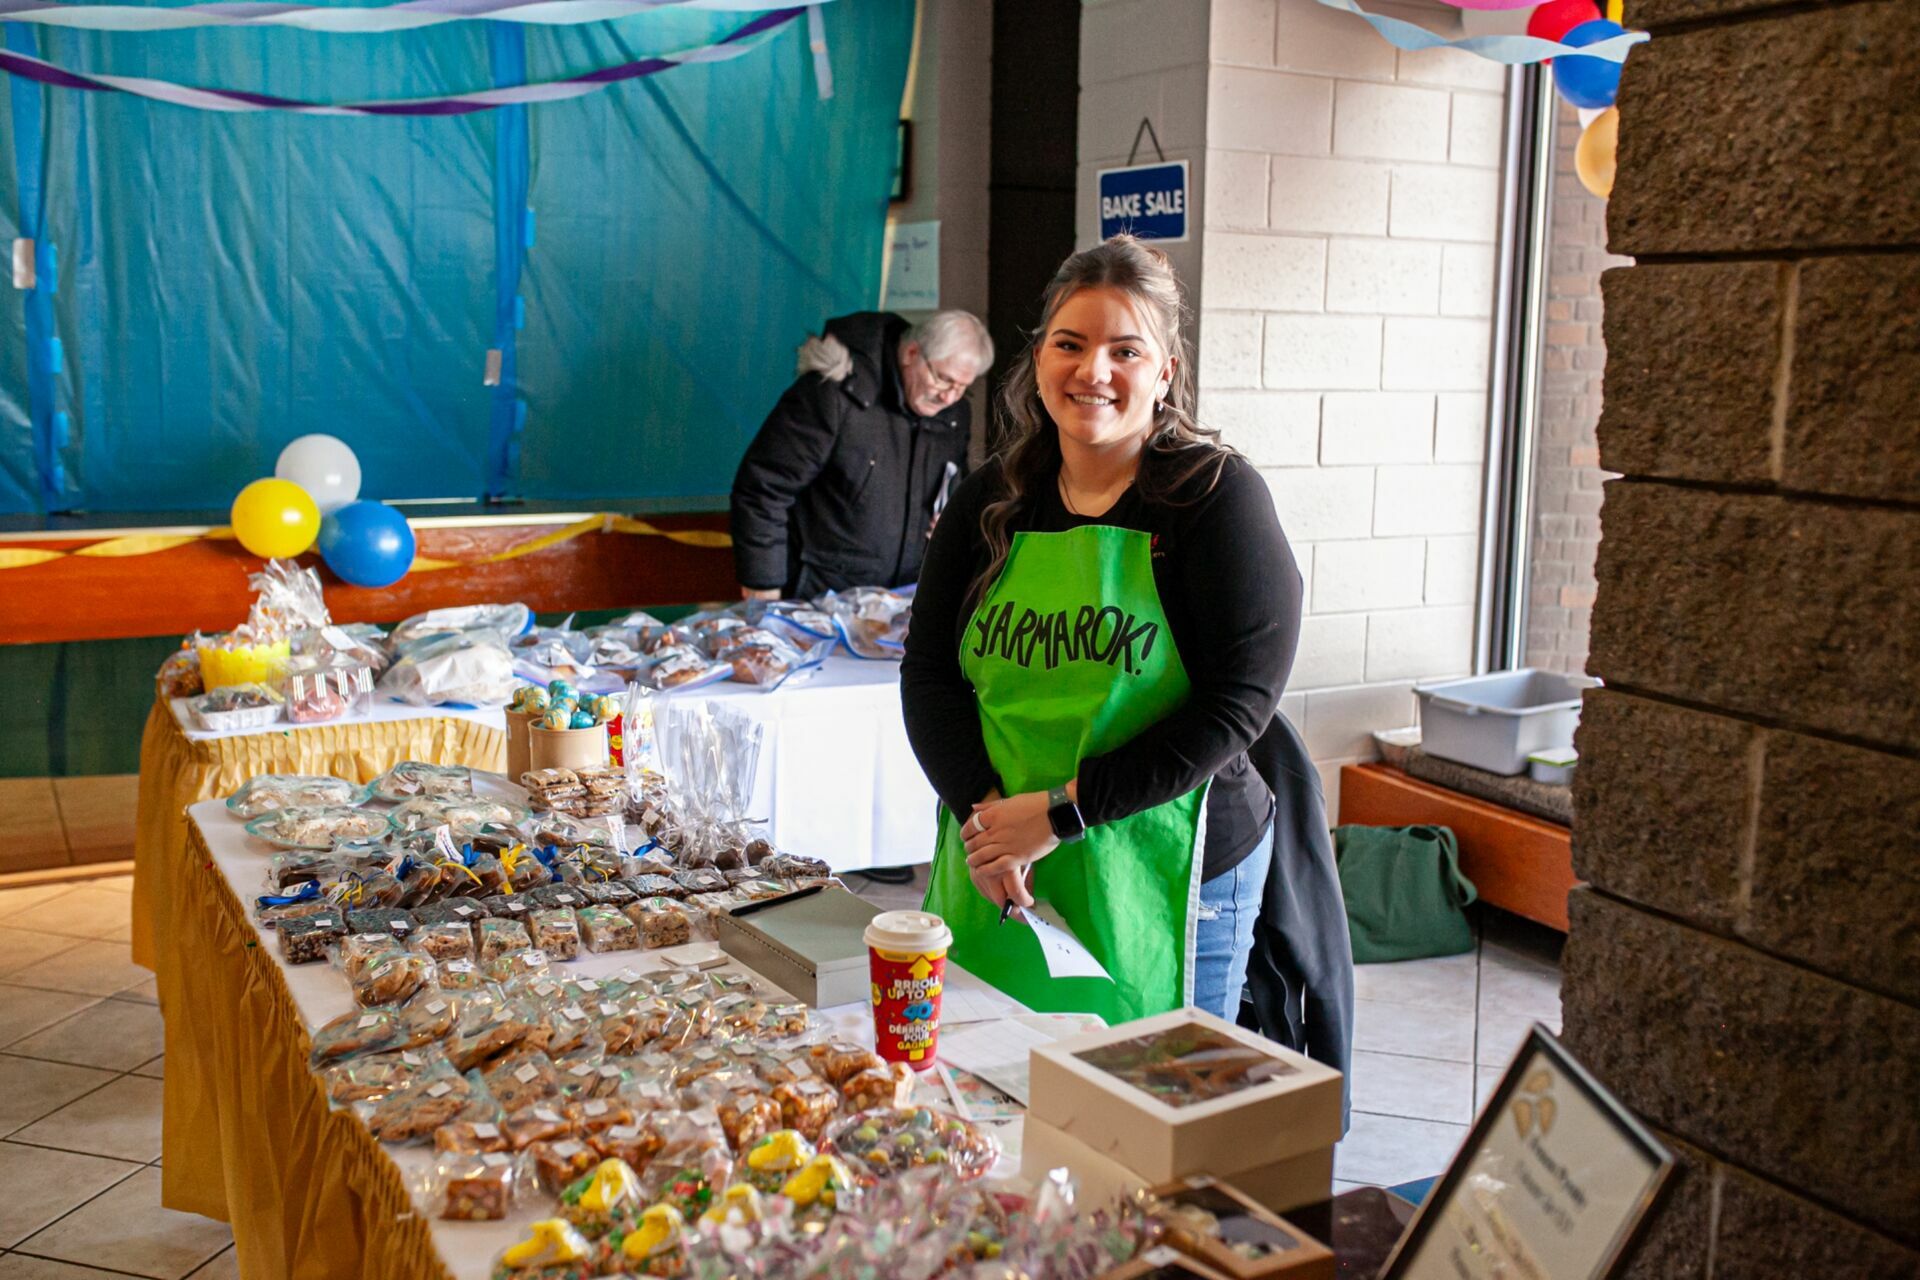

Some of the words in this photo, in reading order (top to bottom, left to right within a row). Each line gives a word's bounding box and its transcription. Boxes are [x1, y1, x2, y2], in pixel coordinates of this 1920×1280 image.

[1102, 193, 1142, 219] BAKE
[1144, 190, 1183, 217] SALE
[972, 601, 1159, 676] YARMAROK!
[903, 1002, 933, 1021] 40
